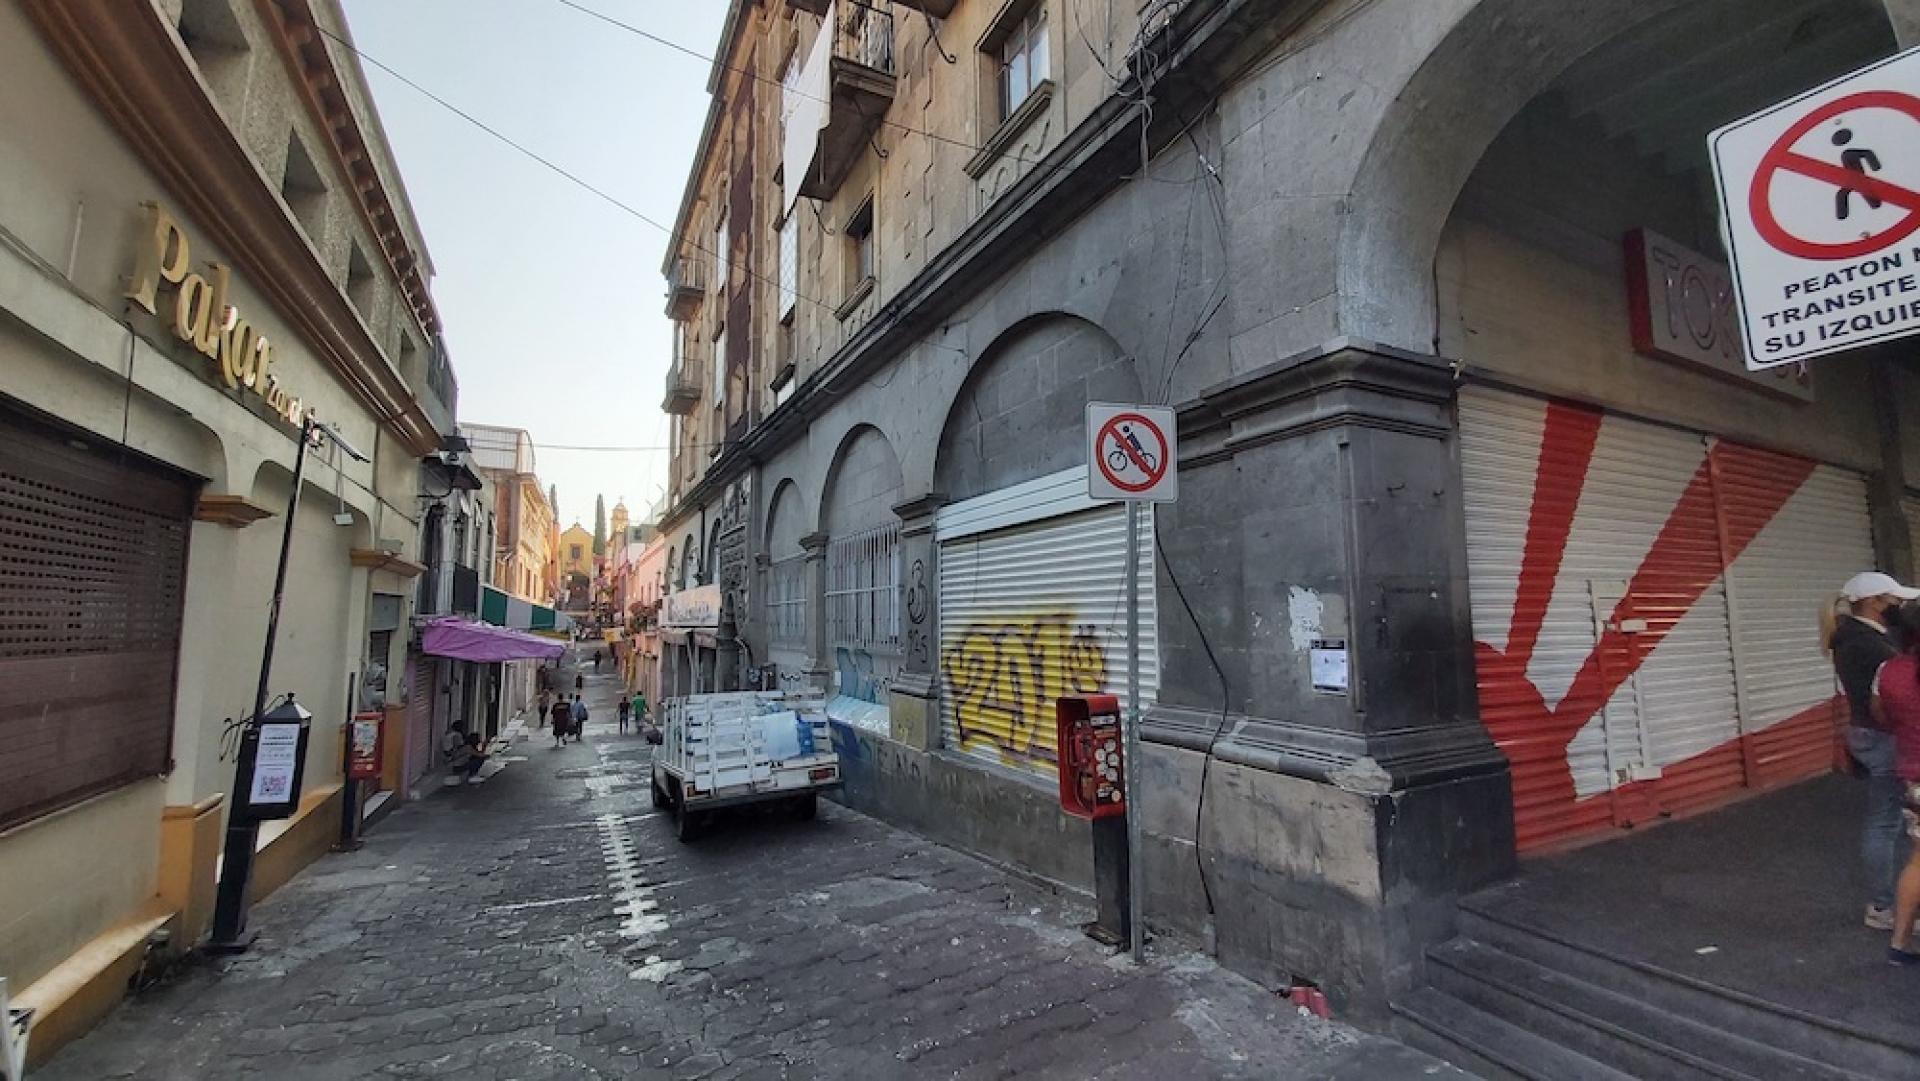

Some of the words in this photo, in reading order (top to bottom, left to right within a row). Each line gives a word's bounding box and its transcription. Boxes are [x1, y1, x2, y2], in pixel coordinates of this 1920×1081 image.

[1784, 253, 1902, 299] PEATON
[1762, 274, 1917, 328] TRANSITE
[1765, 330, 1806, 353] SU
